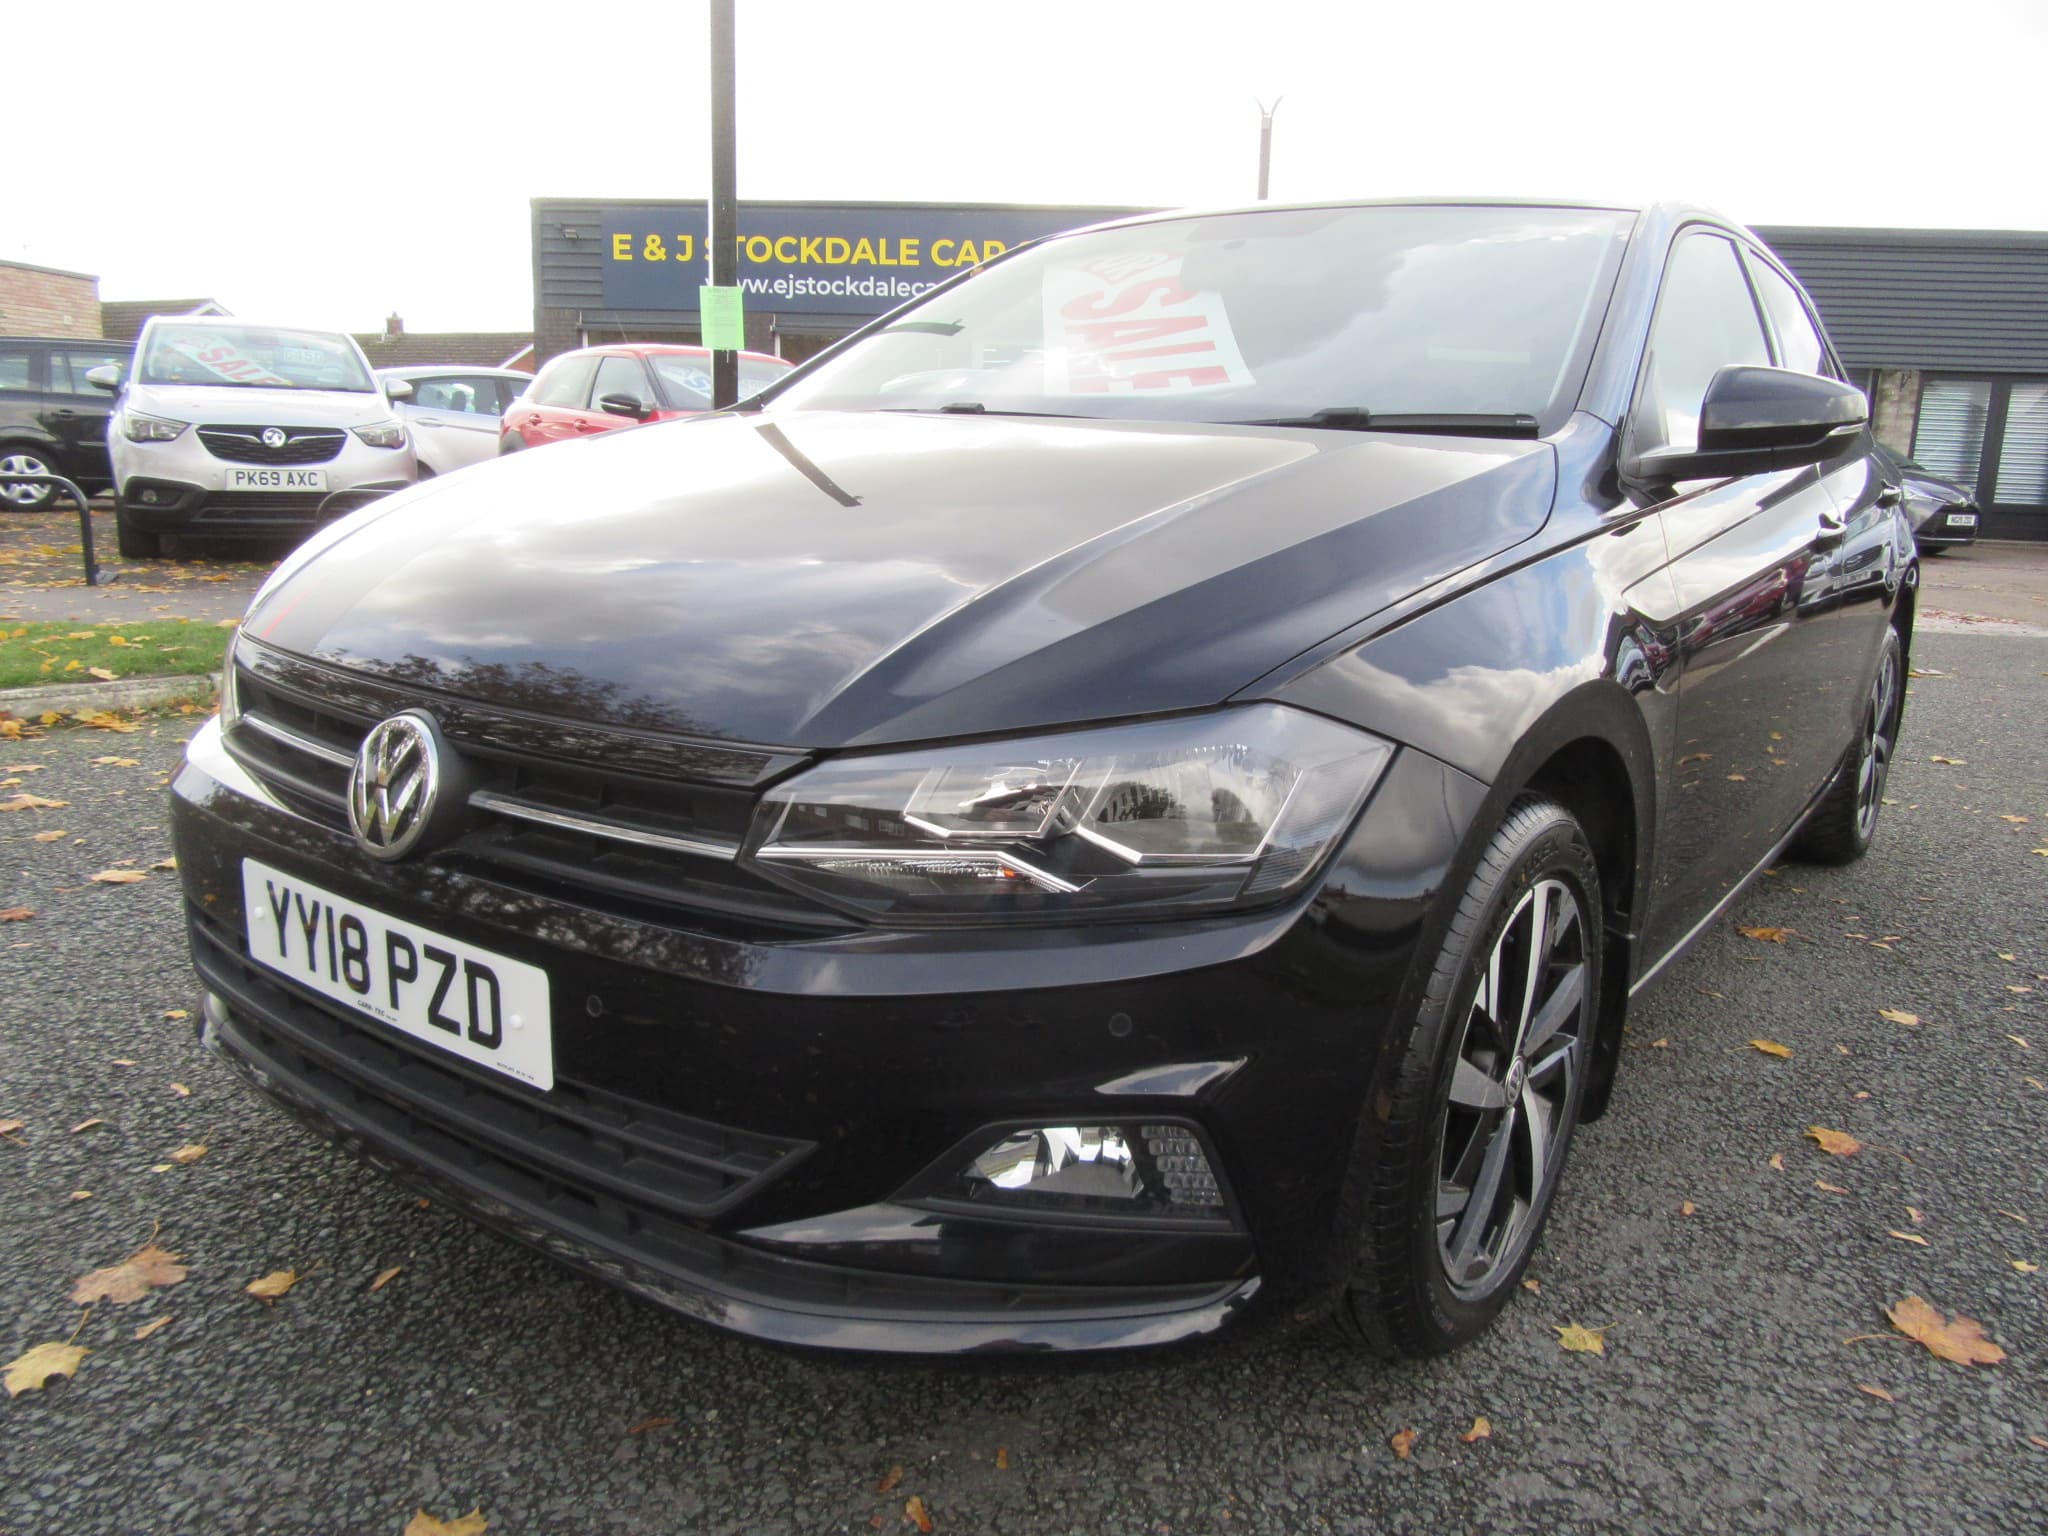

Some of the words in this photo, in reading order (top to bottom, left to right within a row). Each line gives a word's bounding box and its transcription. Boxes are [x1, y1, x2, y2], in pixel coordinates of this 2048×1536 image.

[612, 233, 633, 261] E
[643, 234, 667, 261] &
[675, 234, 694, 262] J
[704, 233, 920, 267] OCKDALE
[235, 471, 280, 486] PK69
[286, 472, 318, 486] AXC
[266, 879, 371, 995] YY18
[385, 929, 503, 1050] PZD
